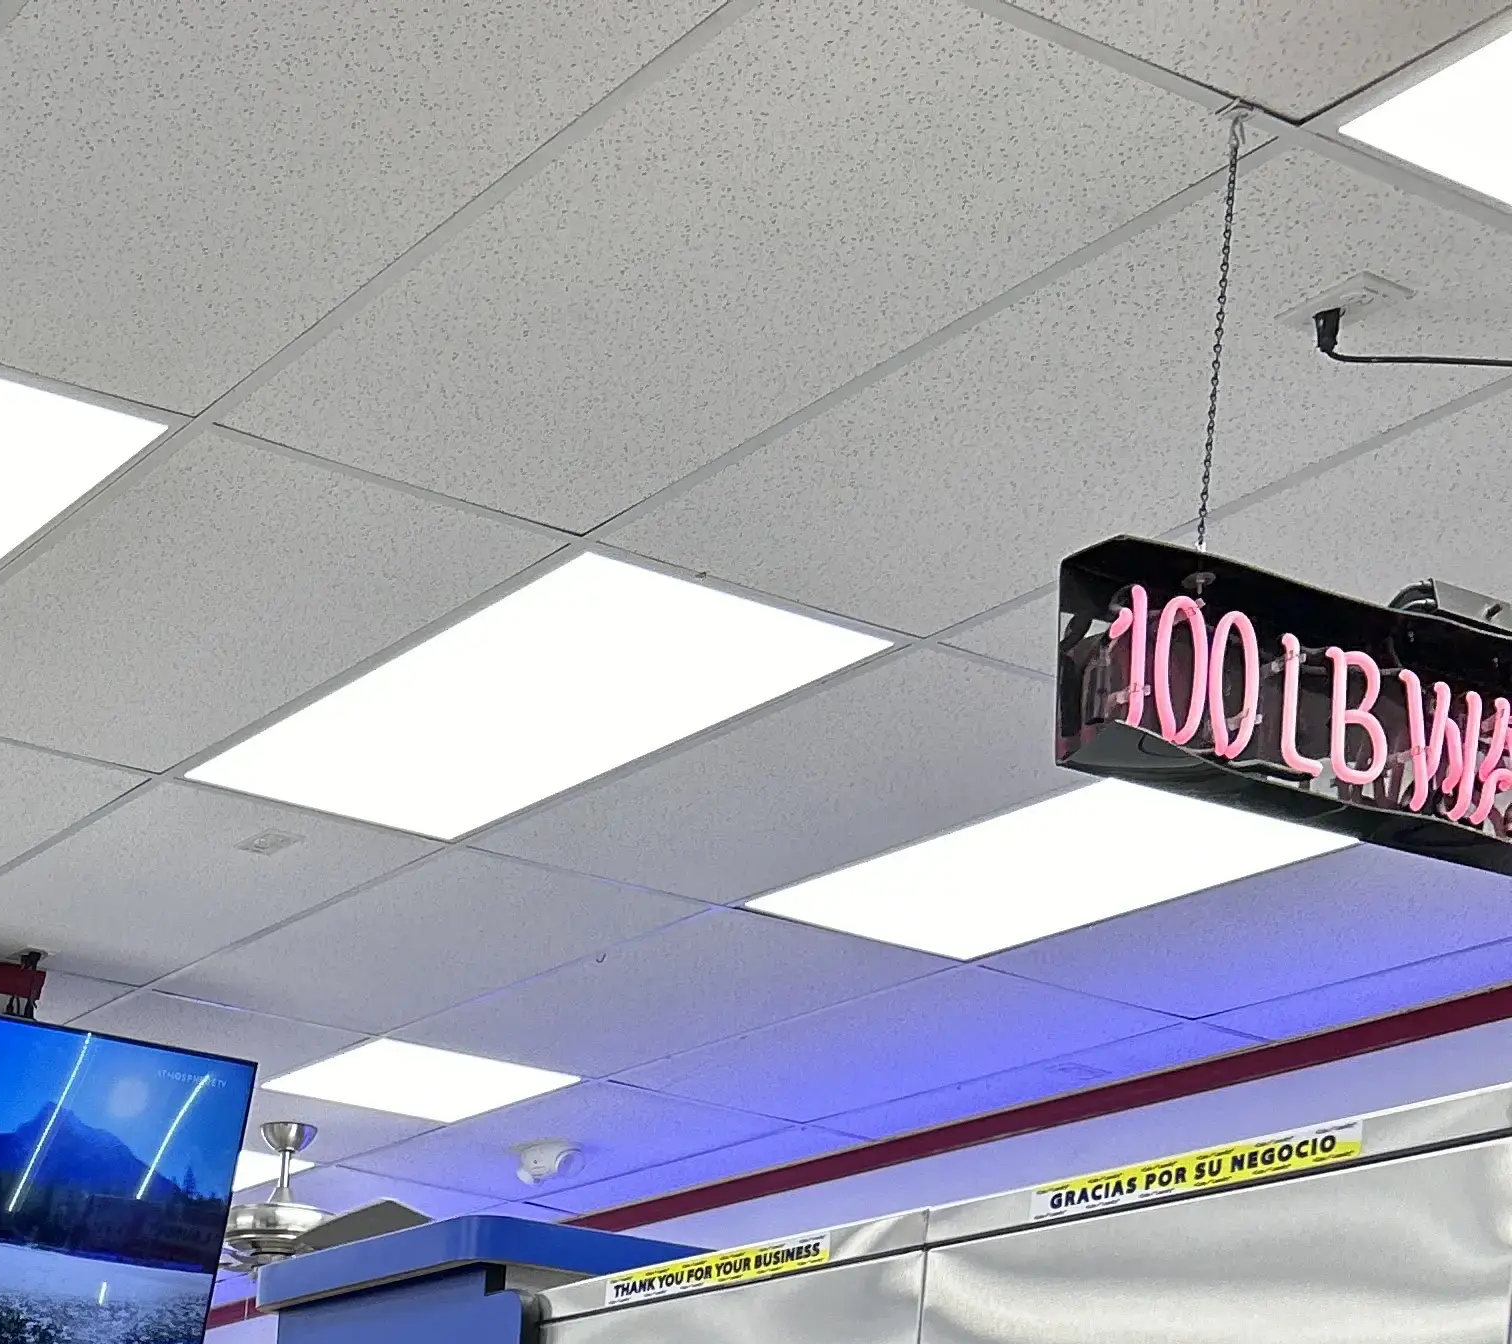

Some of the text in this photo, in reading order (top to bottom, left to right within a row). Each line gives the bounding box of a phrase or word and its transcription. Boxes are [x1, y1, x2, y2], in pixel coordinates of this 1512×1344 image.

[1109, 583, 1261, 760] 100
[1280, 632, 1389, 786] LB
[1049, 1175, 1138, 1211] GRACIAS
[1144, 1165, 1187, 1193] POR
[1193, 1156, 1223, 1181] SU
[1229, 1133, 1337, 1174] NEGOCIO
[614, 1241, 821, 1299] THANK YOU FOR YOUR BUSINESS
